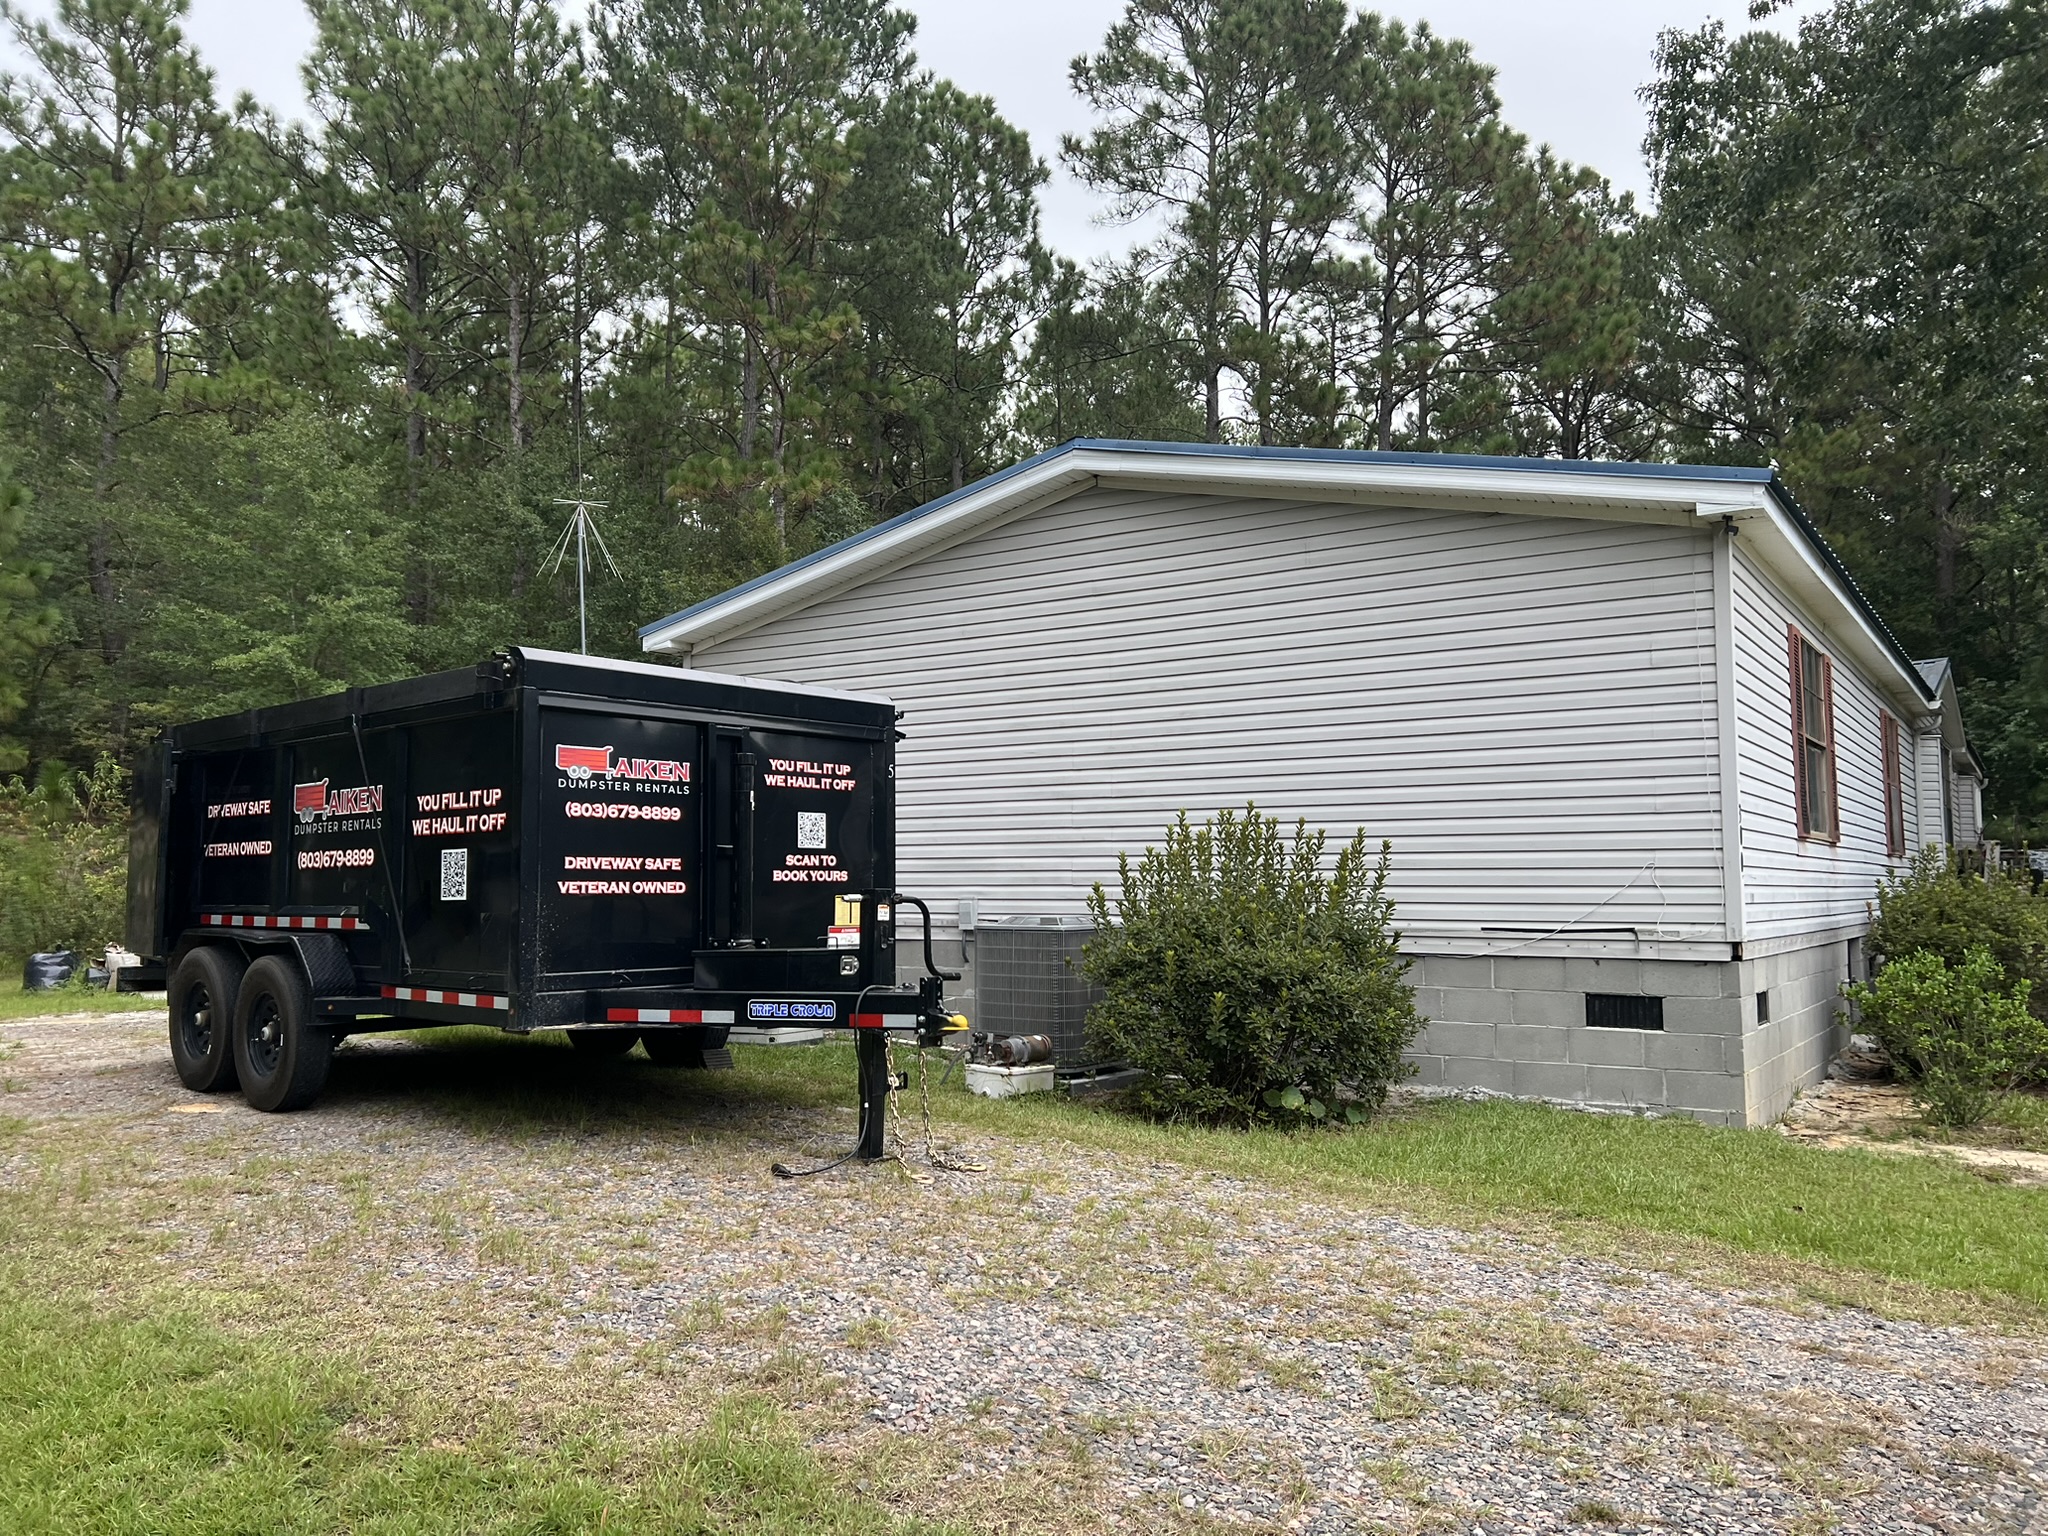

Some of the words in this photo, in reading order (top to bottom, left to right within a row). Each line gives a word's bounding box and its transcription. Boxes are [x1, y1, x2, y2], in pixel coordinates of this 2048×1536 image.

[613, 757, 690, 782] AIKEN
[769, 759, 794, 772] YOU
[796, 761, 822, 774] FILL
[823, 763, 833, 775] IT
[835, 764, 851, 776] UP
[558, 778, 630, 792] DUMPSTER
[636, 783, 690, 795] RENTALS
[764, 774, 786, 787] WE
[787, 776, 820, 789] HAUL
[821, 778, 832, 790] IT
[833, 779, 856, 791] OFF
[248, 800, 271, 815] SAFE
[327, 785, 383, 816] AIKEN
[417, 794, 440, 812] YOU
[441, 791, 468, 810] FILL
[469, 789, 482, 808] IT
[483, 788, 502, 807] UP
[565, 801, 681, 821] (803)679-8899
[294, 821, 339, 835] DUMPSTER
[342, 818, 382, 832] RENTALS
[412, 818, 431, 836] WE
[432, 816, 465, 835] HAUL
[465, 815, 478, 833] IT
[479, 812, 507, 832] OFF
[240, 841, 272, 856] OWNED
[298, 848, 374, 870] (803)679-8899
[564, 856, 643, 870] DRIVEWAY
[644, 858, 682, 871] SAFE
[785, 855, 819, 866] SCAN
[820, 855, 836, 866] TO
[772, 870, 808, 881] BOOK
[809, 870, 848, 881] YOURS
[557, 881, 630, 894] VETERAN
[632, 881, 686, 894] OWNED
[750, 1003, 788, 1016] TRIPLE
[790, 1004, 833, 1017] CROWN
